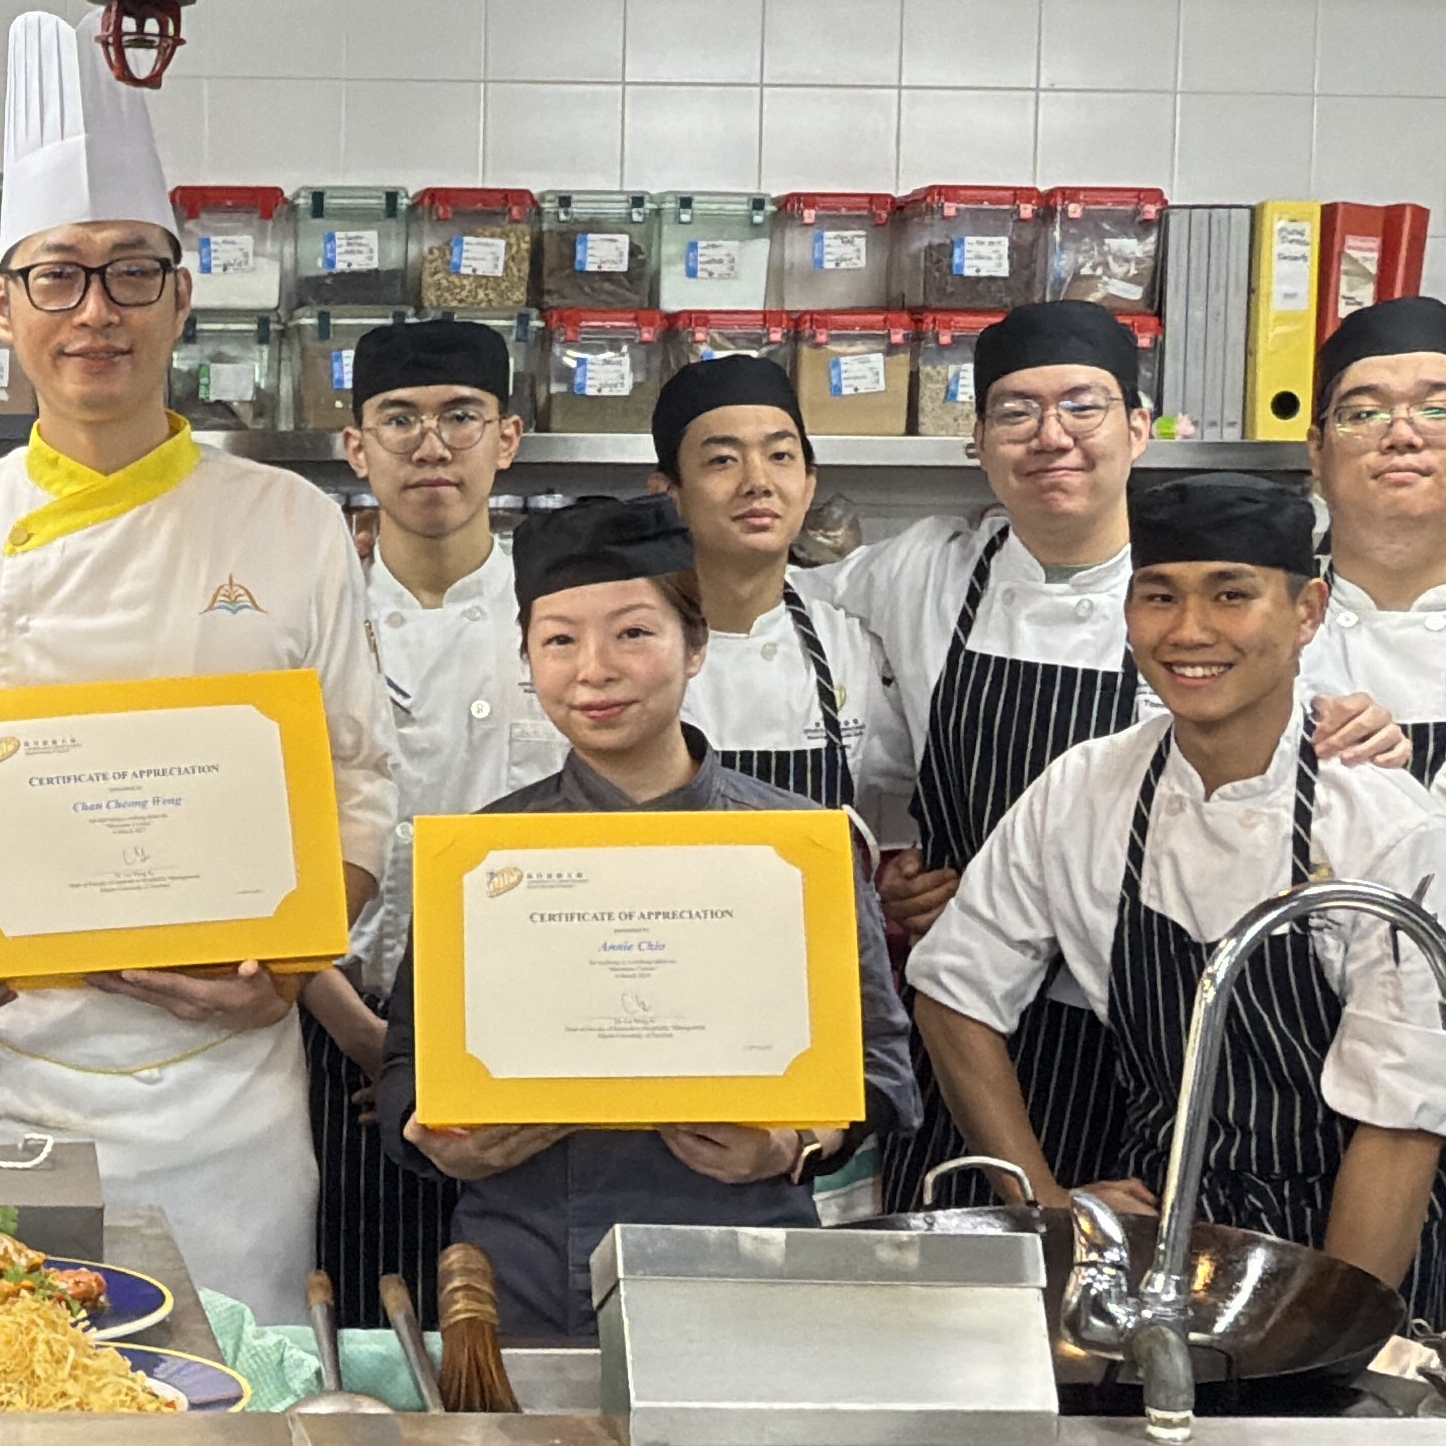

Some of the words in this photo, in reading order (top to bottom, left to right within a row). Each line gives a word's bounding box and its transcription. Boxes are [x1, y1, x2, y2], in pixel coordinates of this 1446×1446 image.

[28, 771, 109, 787] CERTIFICATE
[112, 770, 128, 781] OF
[131, 764, 220, 780] APPRECIATION
[72, 801, 103, 814] Chan
[529, 911, 615, 923] CERTIFICATE
[618, 910, 636, 921] OF
[639, 909, 734, 920] APPRECIATION
[598, 941, 634, 952] Annie
